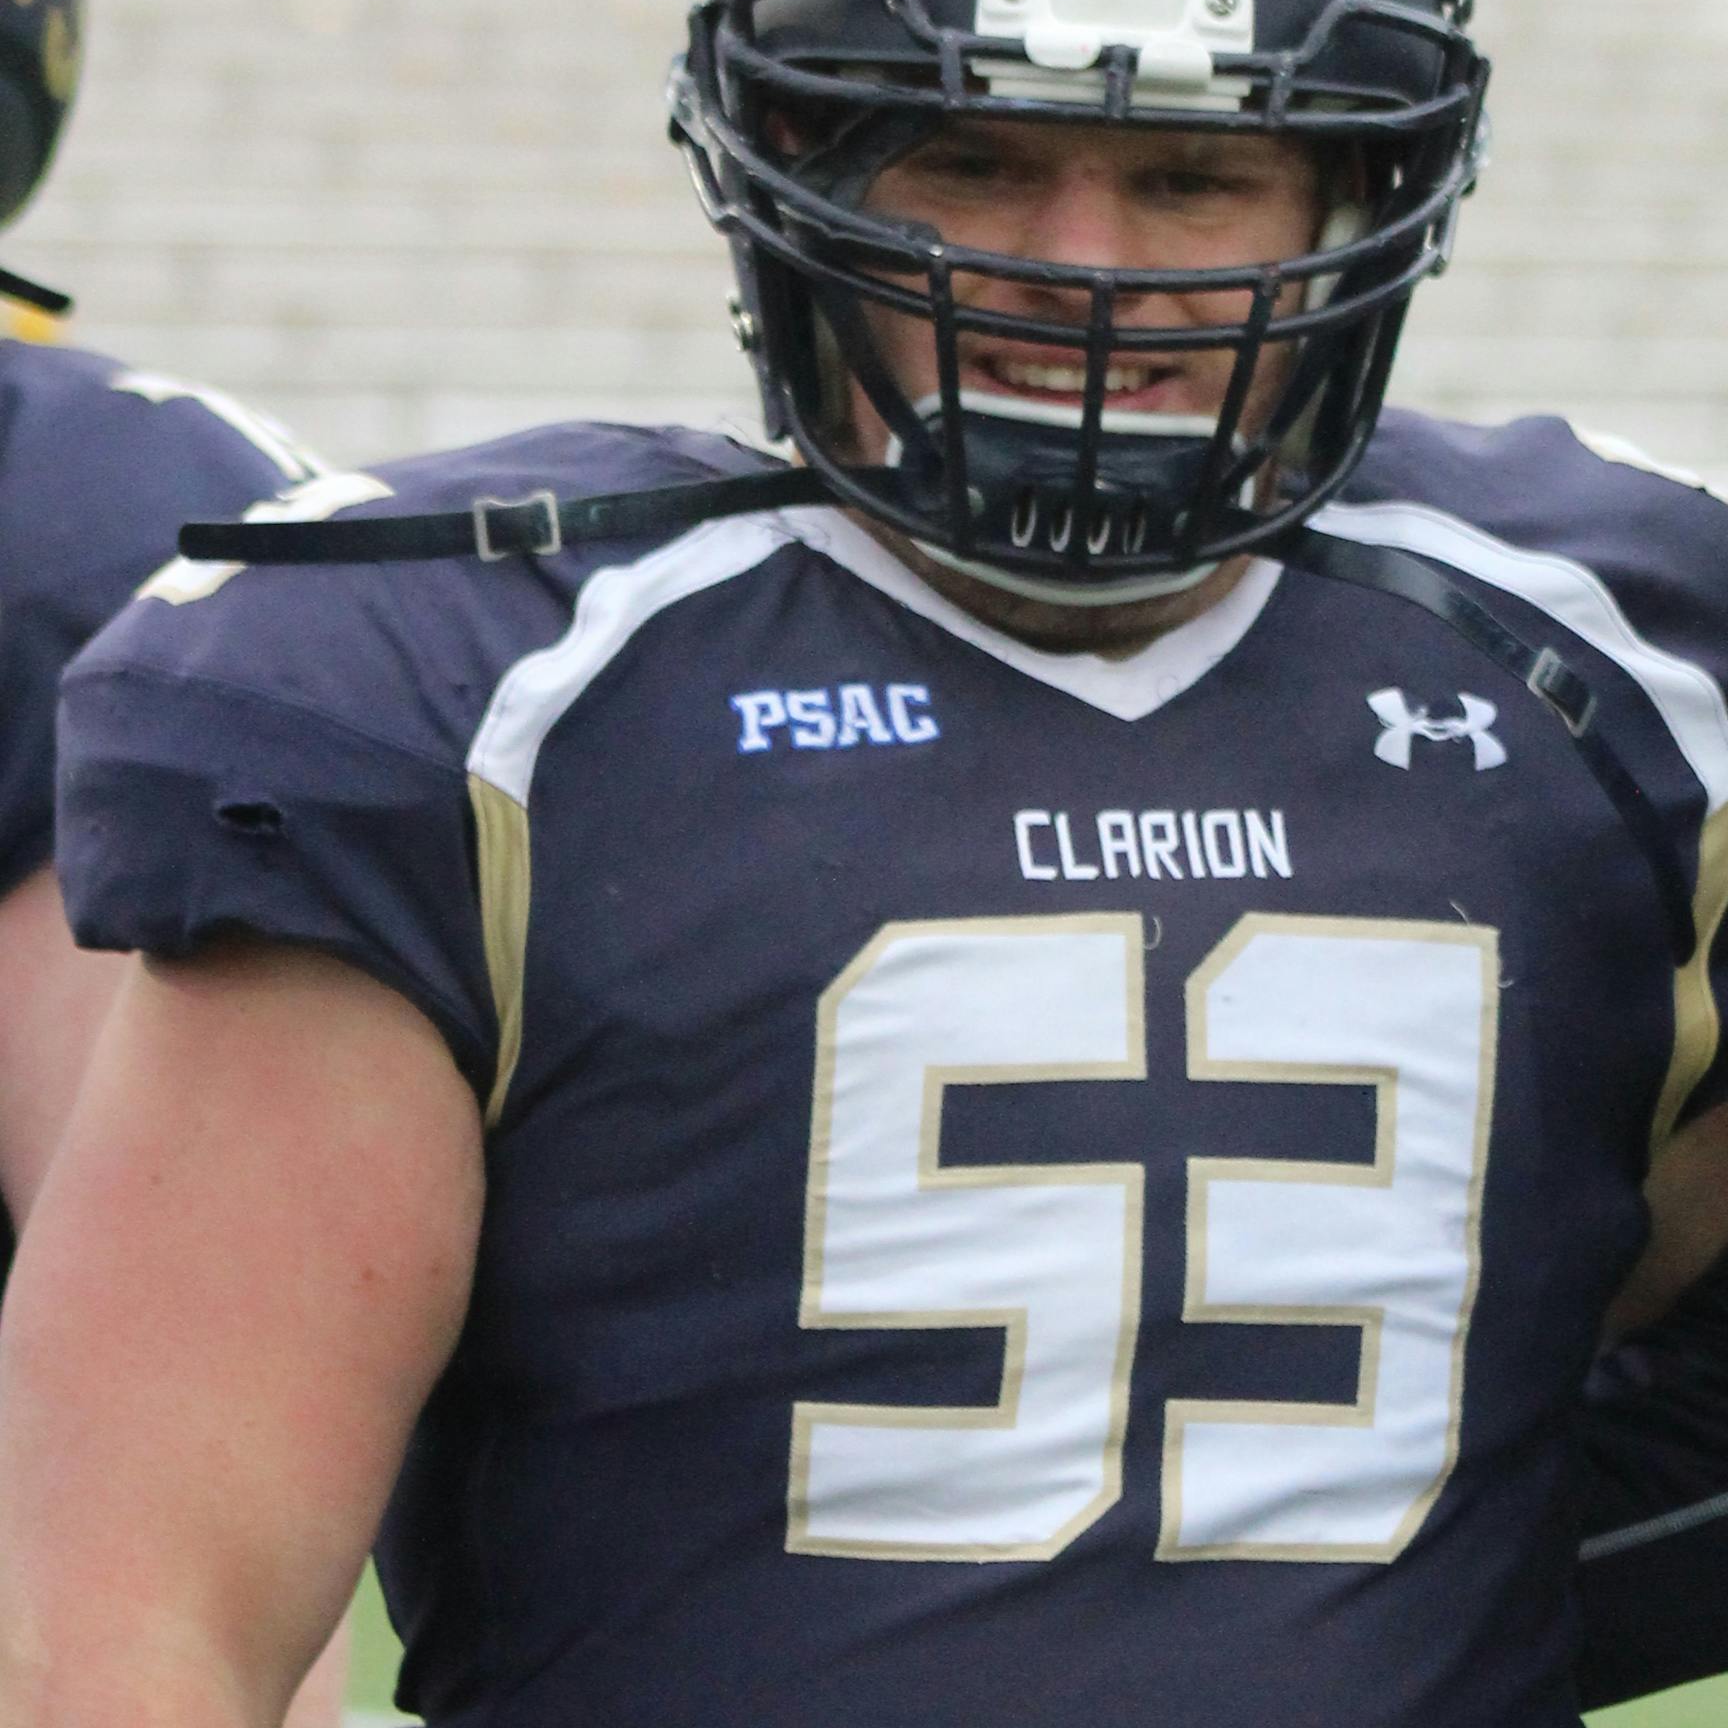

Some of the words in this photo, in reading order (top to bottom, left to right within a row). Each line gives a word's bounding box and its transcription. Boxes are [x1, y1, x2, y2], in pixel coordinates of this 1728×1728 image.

[731, 684, 940, 753] PSAC
[1013, 810, 1294, 880] CLARION
[785, 912, 1500, 1563] 53
